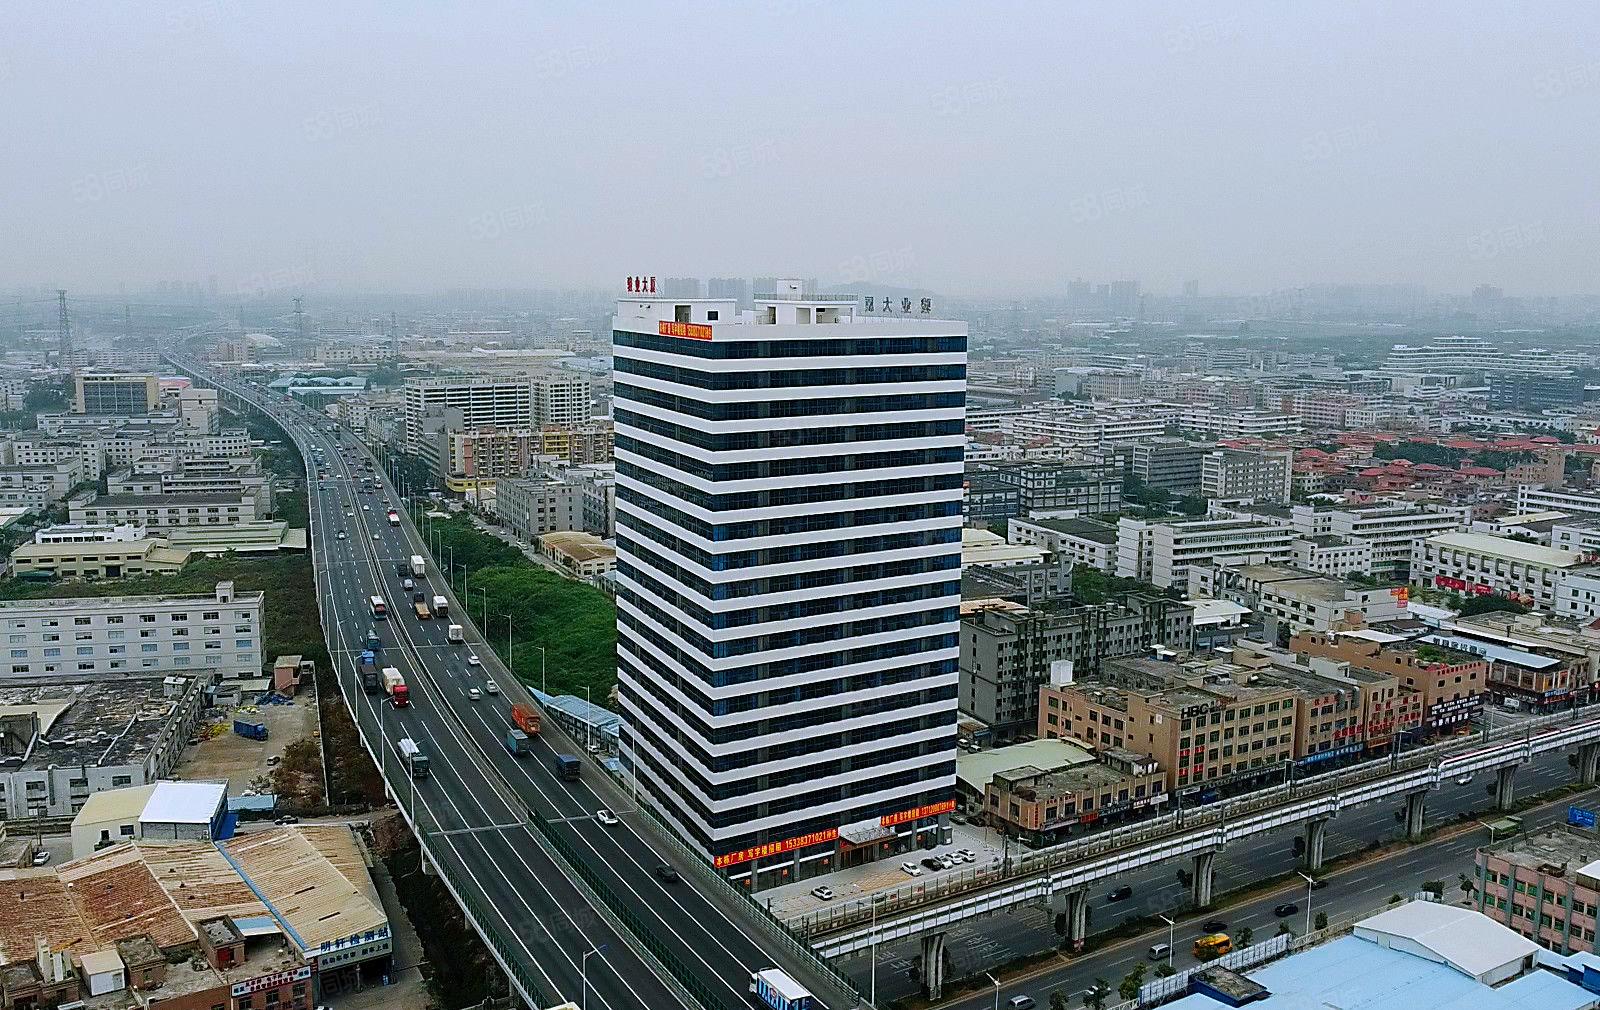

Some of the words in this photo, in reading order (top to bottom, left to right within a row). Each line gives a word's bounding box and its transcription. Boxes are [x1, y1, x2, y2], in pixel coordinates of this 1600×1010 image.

[320, 927, 388, 951] 明轩检测站
